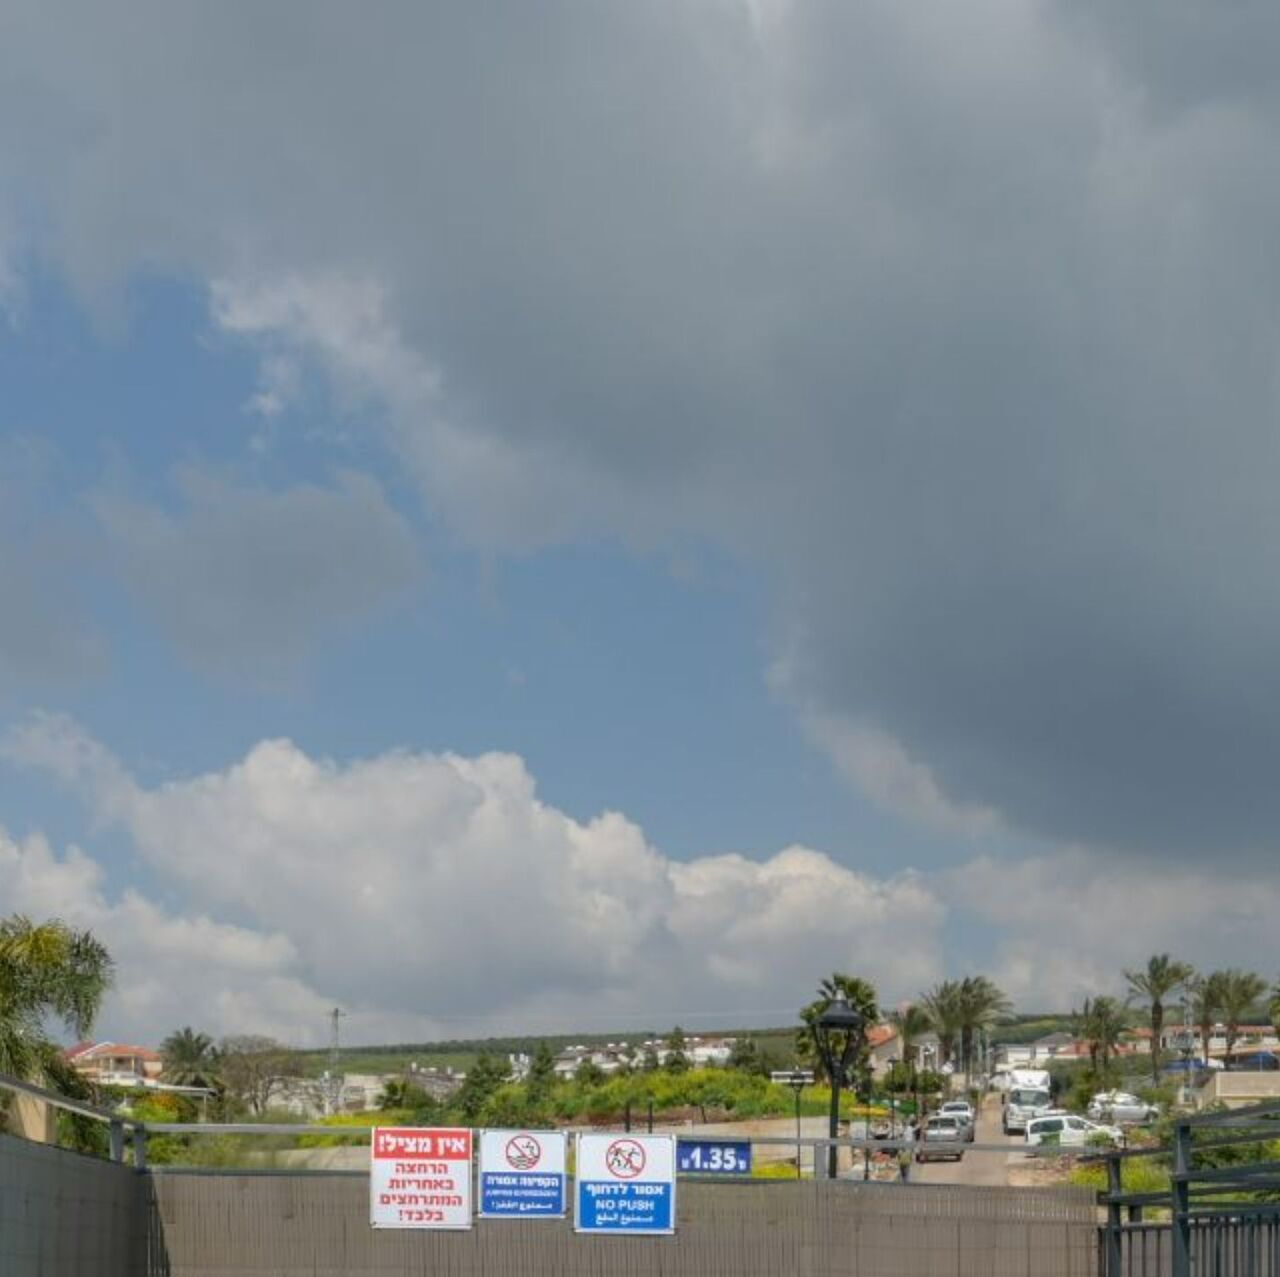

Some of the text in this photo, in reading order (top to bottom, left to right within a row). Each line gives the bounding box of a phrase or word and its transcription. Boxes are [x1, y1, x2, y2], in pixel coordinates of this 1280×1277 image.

[379, 1134, 465, 1156] אין מציל!
[690, 1146, 737, 1171] 1.35
[395, 1163, 448, 1174] הרחצה
[388, 1179, 454, 1190] באחריות
[586, 1183, 665, 1197] אסור לדחוף
[380, 1194, 462, 1206] המתרחצים
[595, 1199, 654, 1211] NO PUSH
[399, 1208, 444, 1221] בלבד!
